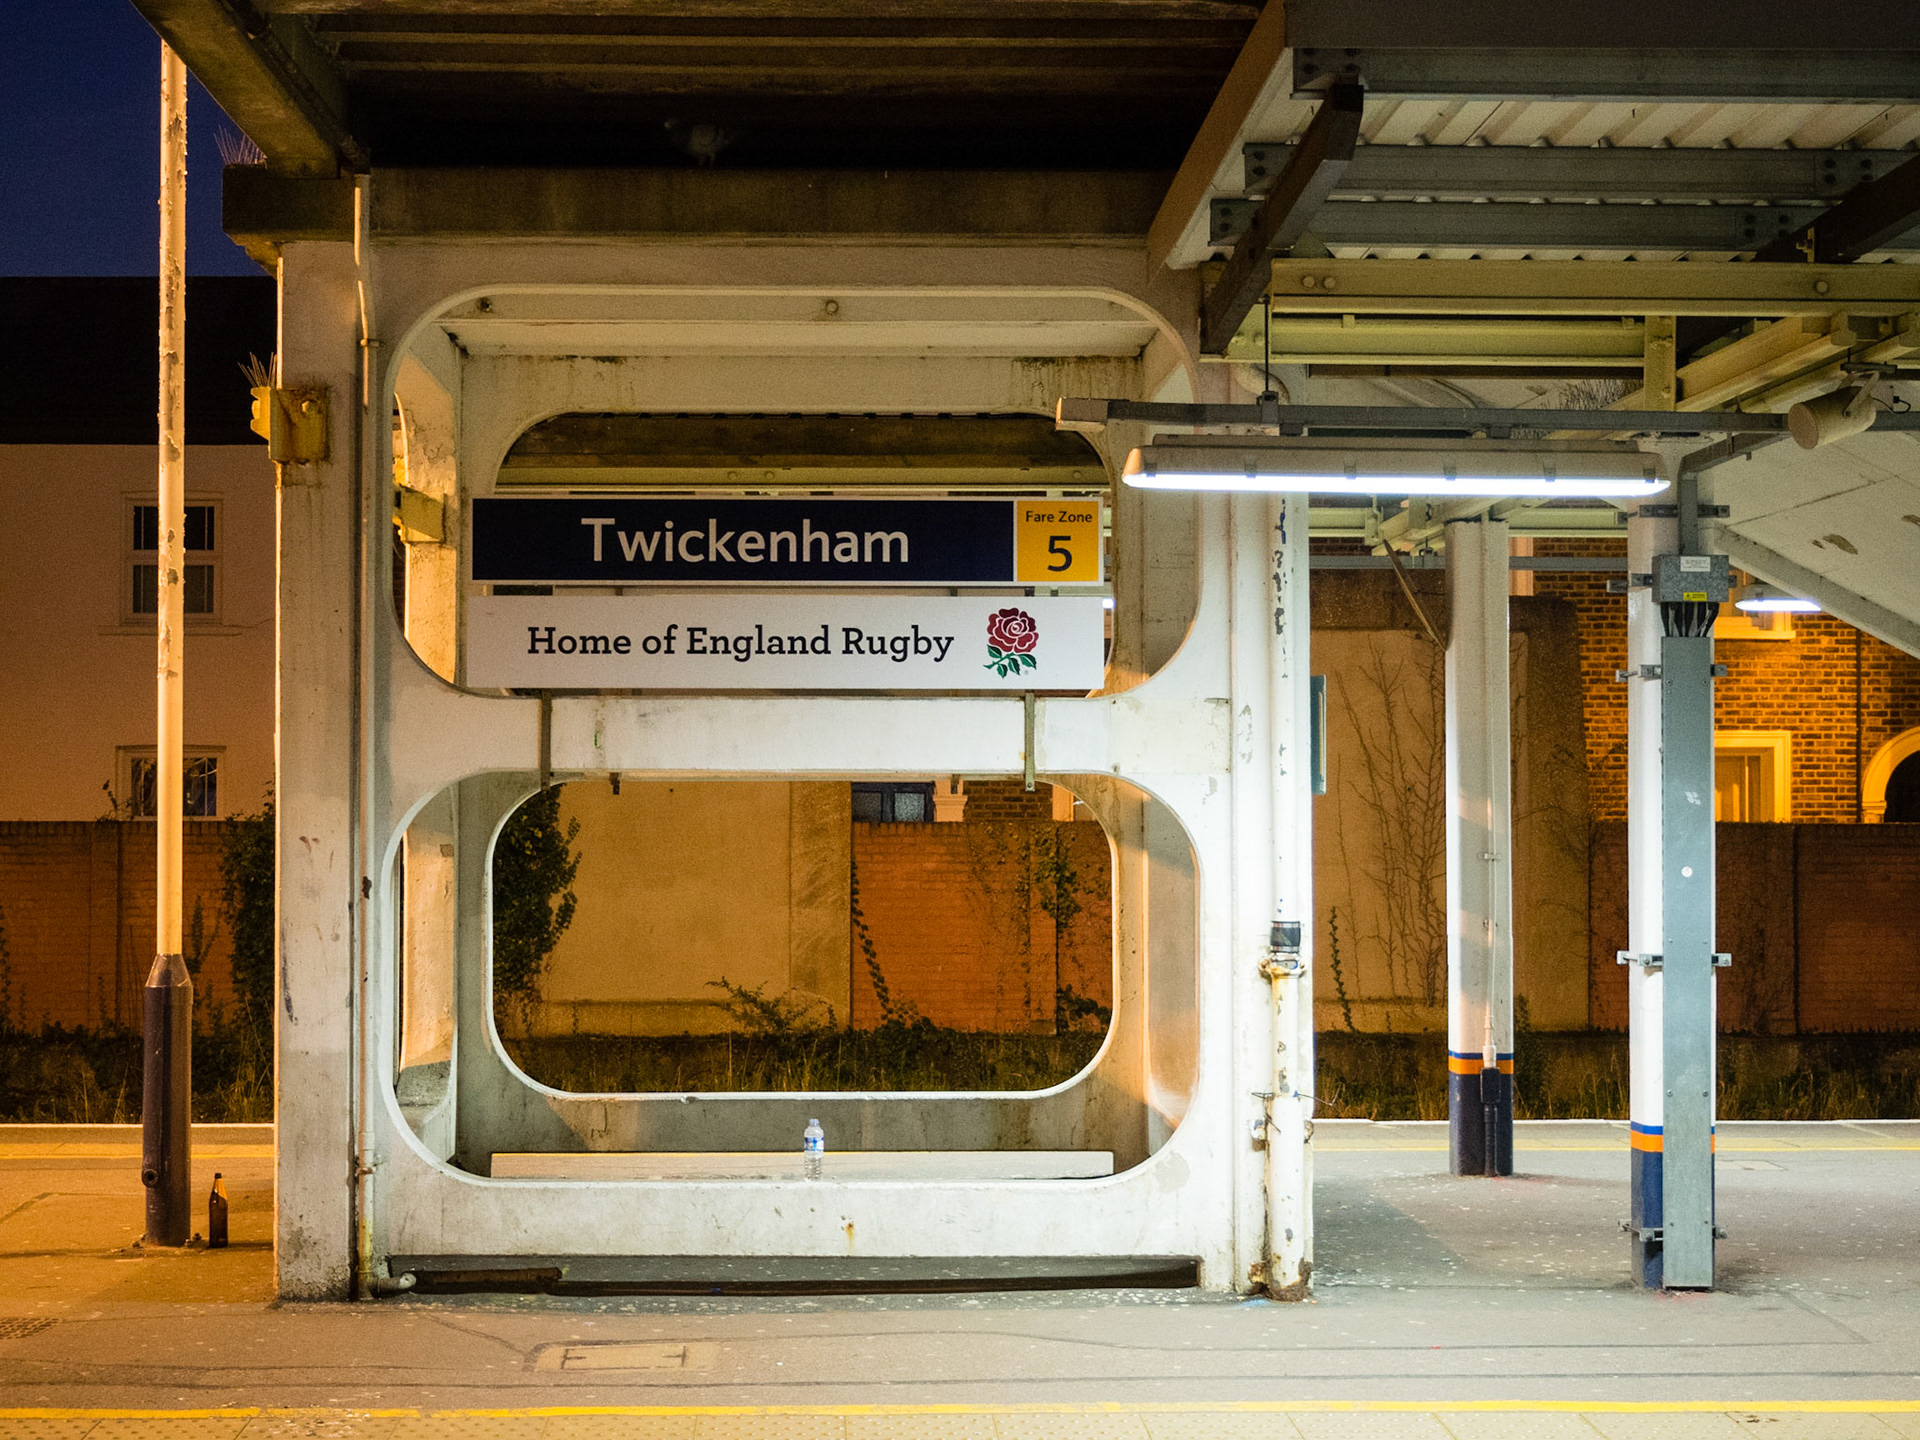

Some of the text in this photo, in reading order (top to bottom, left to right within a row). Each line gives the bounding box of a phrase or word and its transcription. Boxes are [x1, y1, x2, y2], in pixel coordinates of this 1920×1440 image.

[1025, 510, 1093, 523] Fare Zone
[582, 518, 908, 562] Twickenham
[1048, 536, 1072, 571] 5
[528, 624, 954, 662] Home of England Rugby
